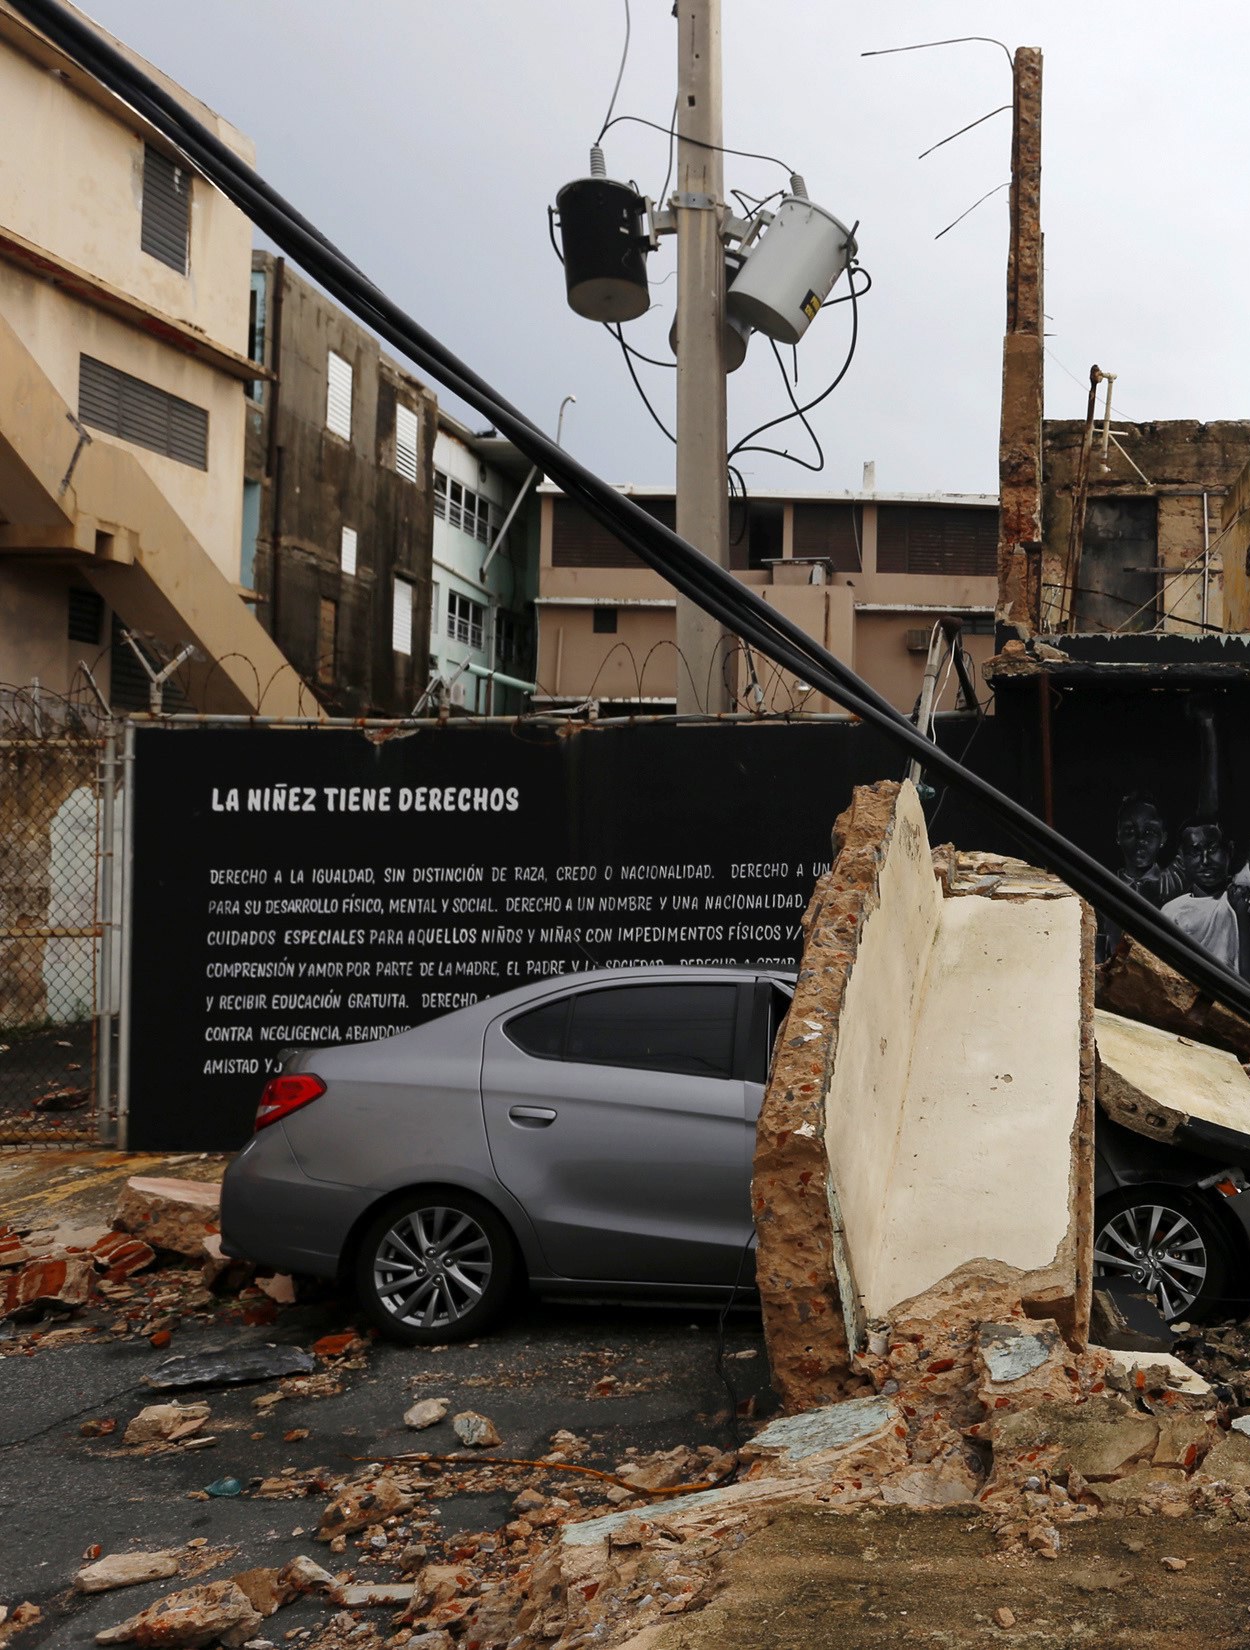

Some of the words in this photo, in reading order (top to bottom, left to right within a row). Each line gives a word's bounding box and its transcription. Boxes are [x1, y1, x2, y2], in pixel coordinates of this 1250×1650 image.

[211, 787, 240, 812] LA
[247, 783, 317, 812] NIÑEZ
[323, 786, 392, 812] TIENE
[398, 786, 520, 812] DERECHOS
[209, 869, 268, 885] DERECHO
[273, 869, 284, 884] A
[290, 869, 305, 885] LA
[311, 868, 376, 886] IGUALDAD,
[383, 867, 406, 883] SIN
[412, 863, 485, 884] DISTINCIÓN
[491, 866, 508, 883] DE
[514, 866, 549, 883] RAZA,
[556, 865, 598, 882] CREDO
[604, 865, 614, 881] O
[620, 864, 715, 881] NACIONALIDAD.
[730, 862, 789, 879] DERECHO
[796, 863, 805, 877] A
[208, 900, 241, 916] PARA
[244, 899, 262, 916] SU
[265, 898, 339, 915] DESARROLLO
[342, 894, 385, 916] FÍSICO,
[389, 898, 438, 914] MENTAL
[441, 898, 450, 913] Y
[451, 897, 499, 914] SOCIAL.
[505, 896, 562, 913] DERECHO
[565, 898, 573, 912] A
[577, 896, 595, 912] UN
[598, 895, 653, 912] NOMBRE
[659, 896, 668, 911] Y
[672, 894, 699, 911] UNA
[704, 893, 807, 910] NACIONALIDAD.
[206, 930, 277, 946] CUIDADOS
[283, 928, 366, 946] ESPECIALES
[369, 929, 404, 945] PARA
[407, 927, 477, 946] AQUELLOS
[480, 925, 524, 944] NIÑOS
[527, 928, 536, 944] Y
[540, 925, 582, 944] NIÑAS
[585, 928, 613, 943] CON
[617, 926, 724, 943] IMPEDIMENTOS
[728, 921, 782, 941] FÍSICOS
[785, 925, 805, 940] Y/
[206, 956, 295, 978] COMPRENSIÓN
[298, 962, 307, 977] Y
[307, 961, 344, 977] AMOR
[346, 961, 371, 977] POR
[375, 961, 414, 976] PARTE
[419, 961, 435, 977] DE
[437, 961, 453, 976] LA
[455, 960, 500, 978] MADRE,
[506, 960, 520, 975] EL
[526, 959, 566, 976] PADRE
[570, 959, 580, 973] Y
[206, 996, 214, 1012] Y
[219, 994, 268, 1011] RECIBIR
[271, 988, 342, 1010] EDUCACIÓN
[347, 993, 410, 1009] GRATUITA.
[420, 991, 478, 1009] DERECHO
[204, 1026, 254, 1042] CONTRA
[260, 1025, 342, 1042] NEGLIGENCIA,
[203, 1058, 259, 1075] AMISTAD
[264, 1058, 274, 1074] Y
